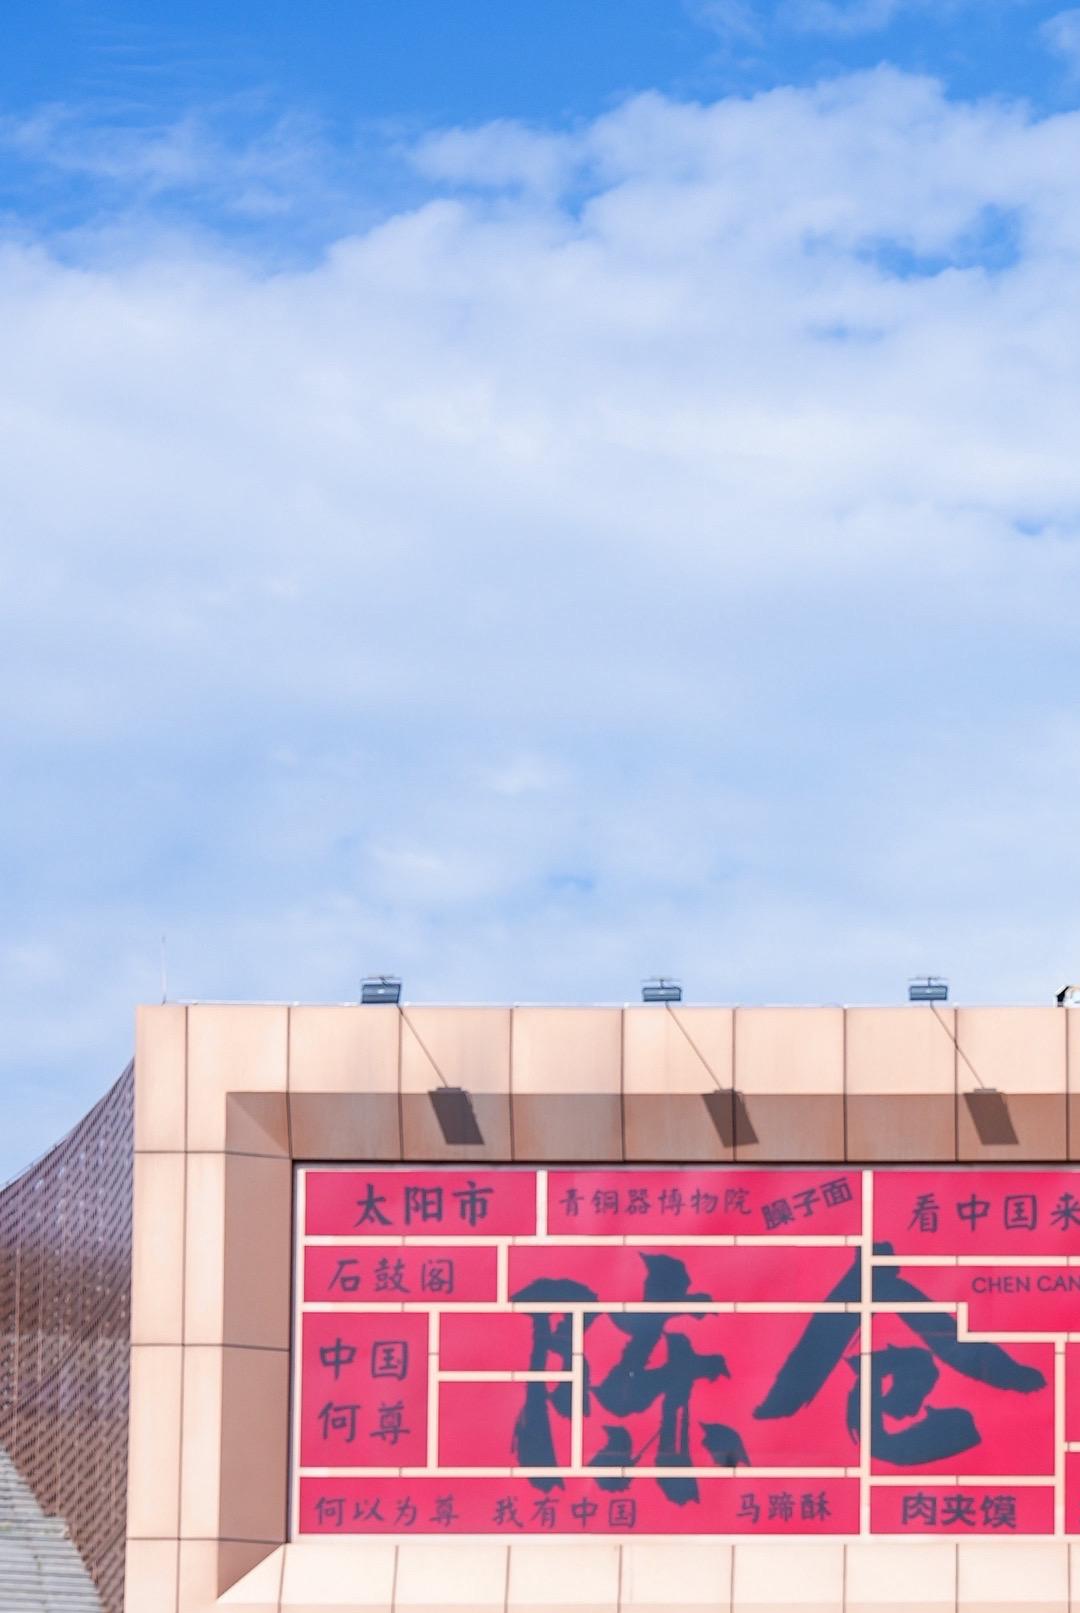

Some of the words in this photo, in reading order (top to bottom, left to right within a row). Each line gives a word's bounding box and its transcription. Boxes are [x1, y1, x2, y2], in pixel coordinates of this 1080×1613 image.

[355, 1182, 494, 1227] 太阳市
[559, 1187, 751, 1216] 青铜器博物院
[328, 1259, 455, 1294] 石鼓阁
[971, 1274, 1031, 1295] CHEN
[318, 1338, 410, 1381] 中国
[318, 1402, 411, 1445] 何尊
[315, 1496, 459, 1526] 何以为尊
[493, 1496, 637, 1528] 我有中国
[736, 1492, 832, 1524] 马蹄酥
[901, 1494, 1017, 1528] 肉夹馍
